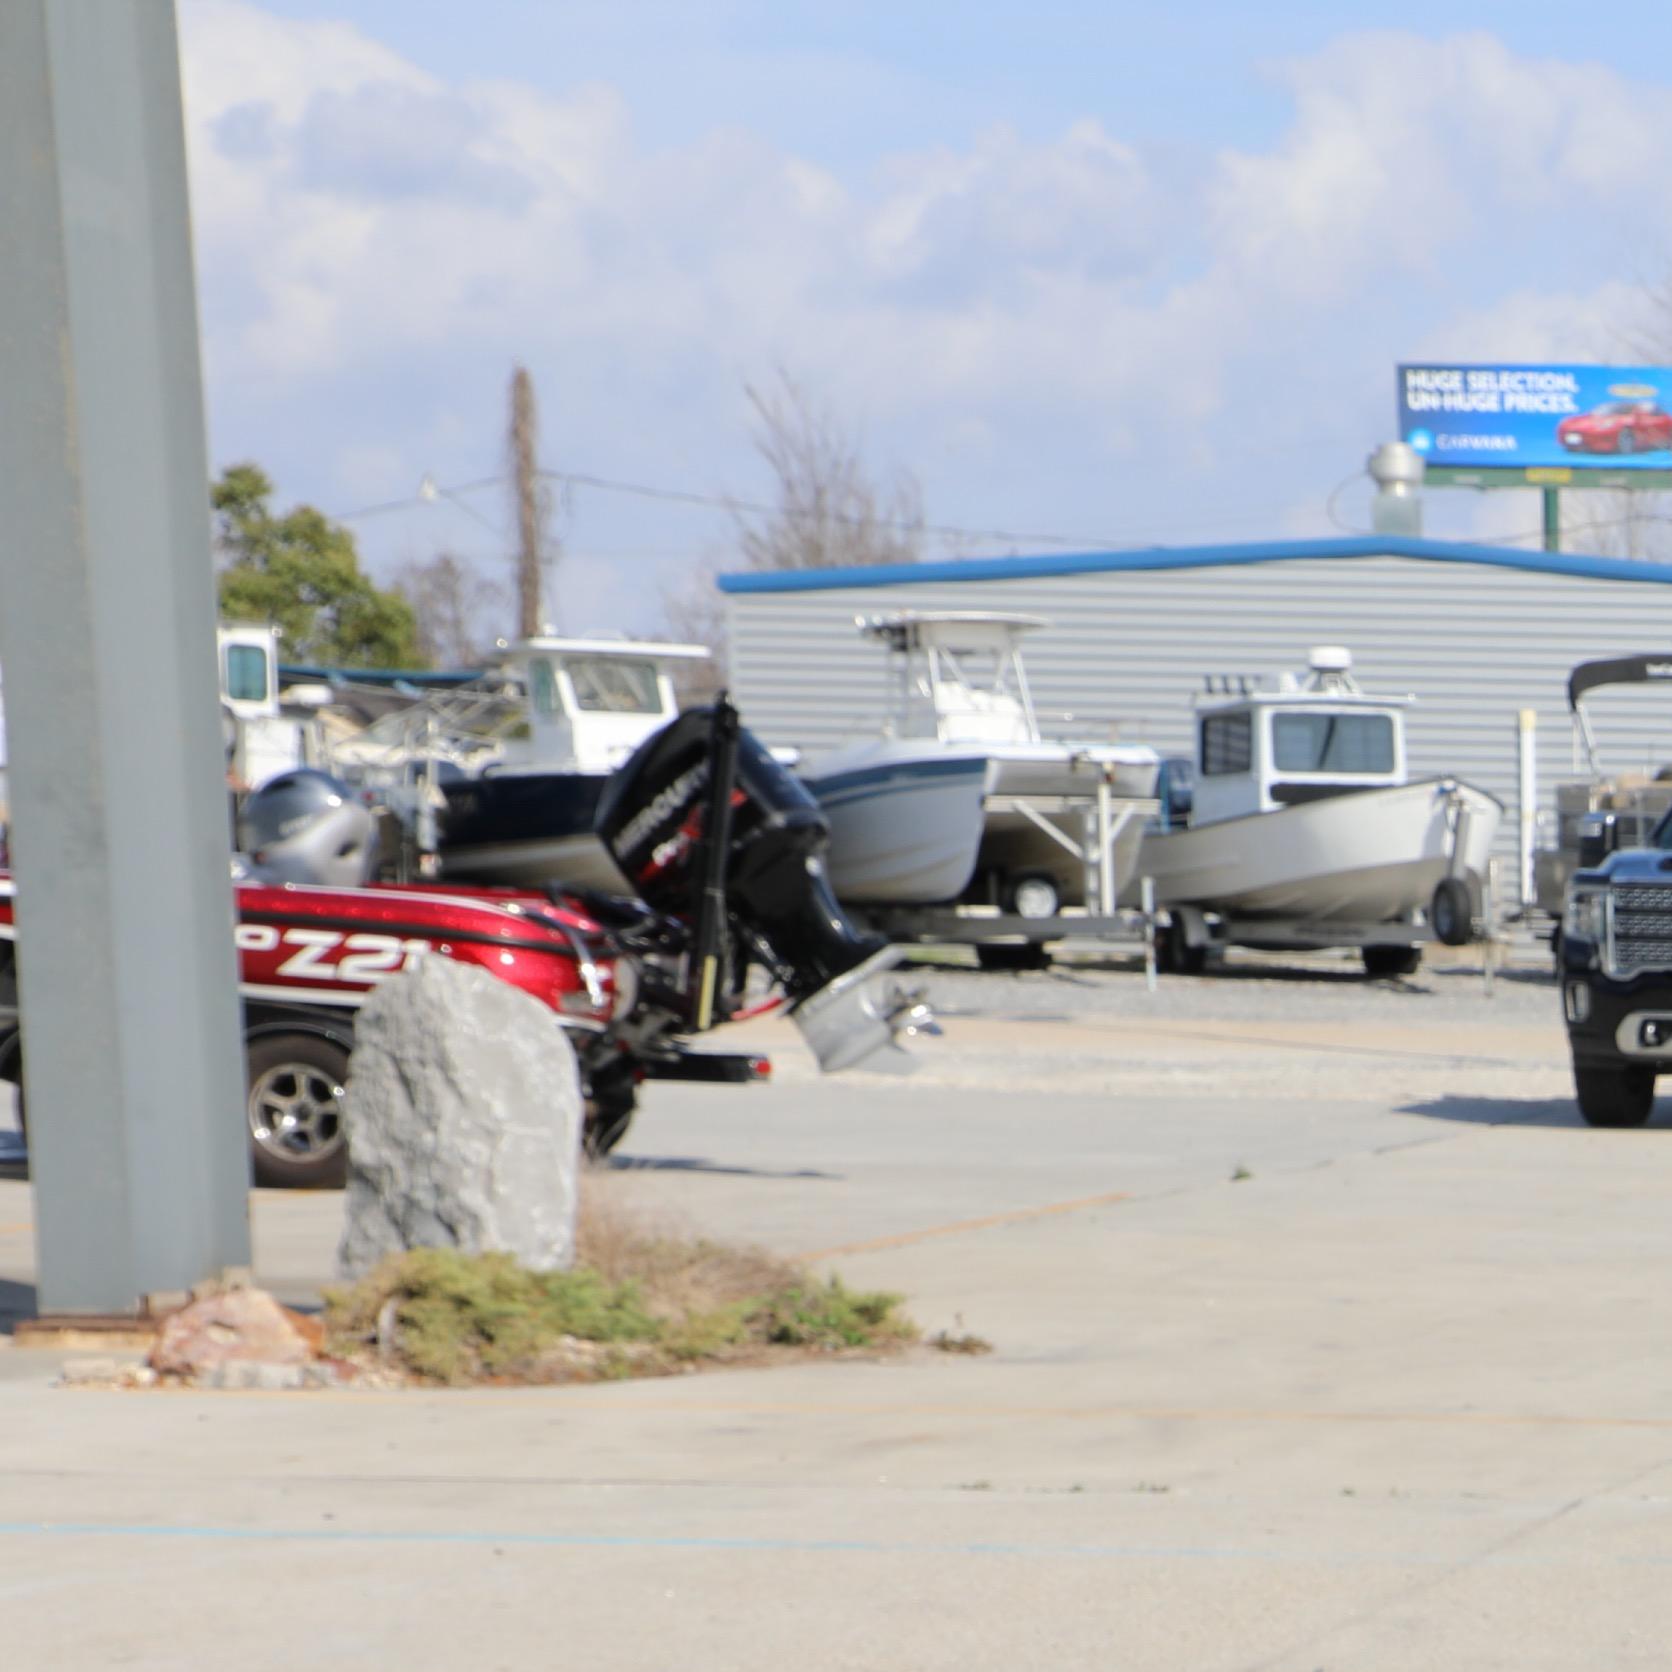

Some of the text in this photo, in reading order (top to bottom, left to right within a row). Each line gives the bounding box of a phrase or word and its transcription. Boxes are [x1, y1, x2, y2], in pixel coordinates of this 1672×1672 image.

[1406, 370, 1463, 391] HUGE
[1407, 391, 1500, 412] UN-HUGE
[275, 928, 431, 983] Z21
